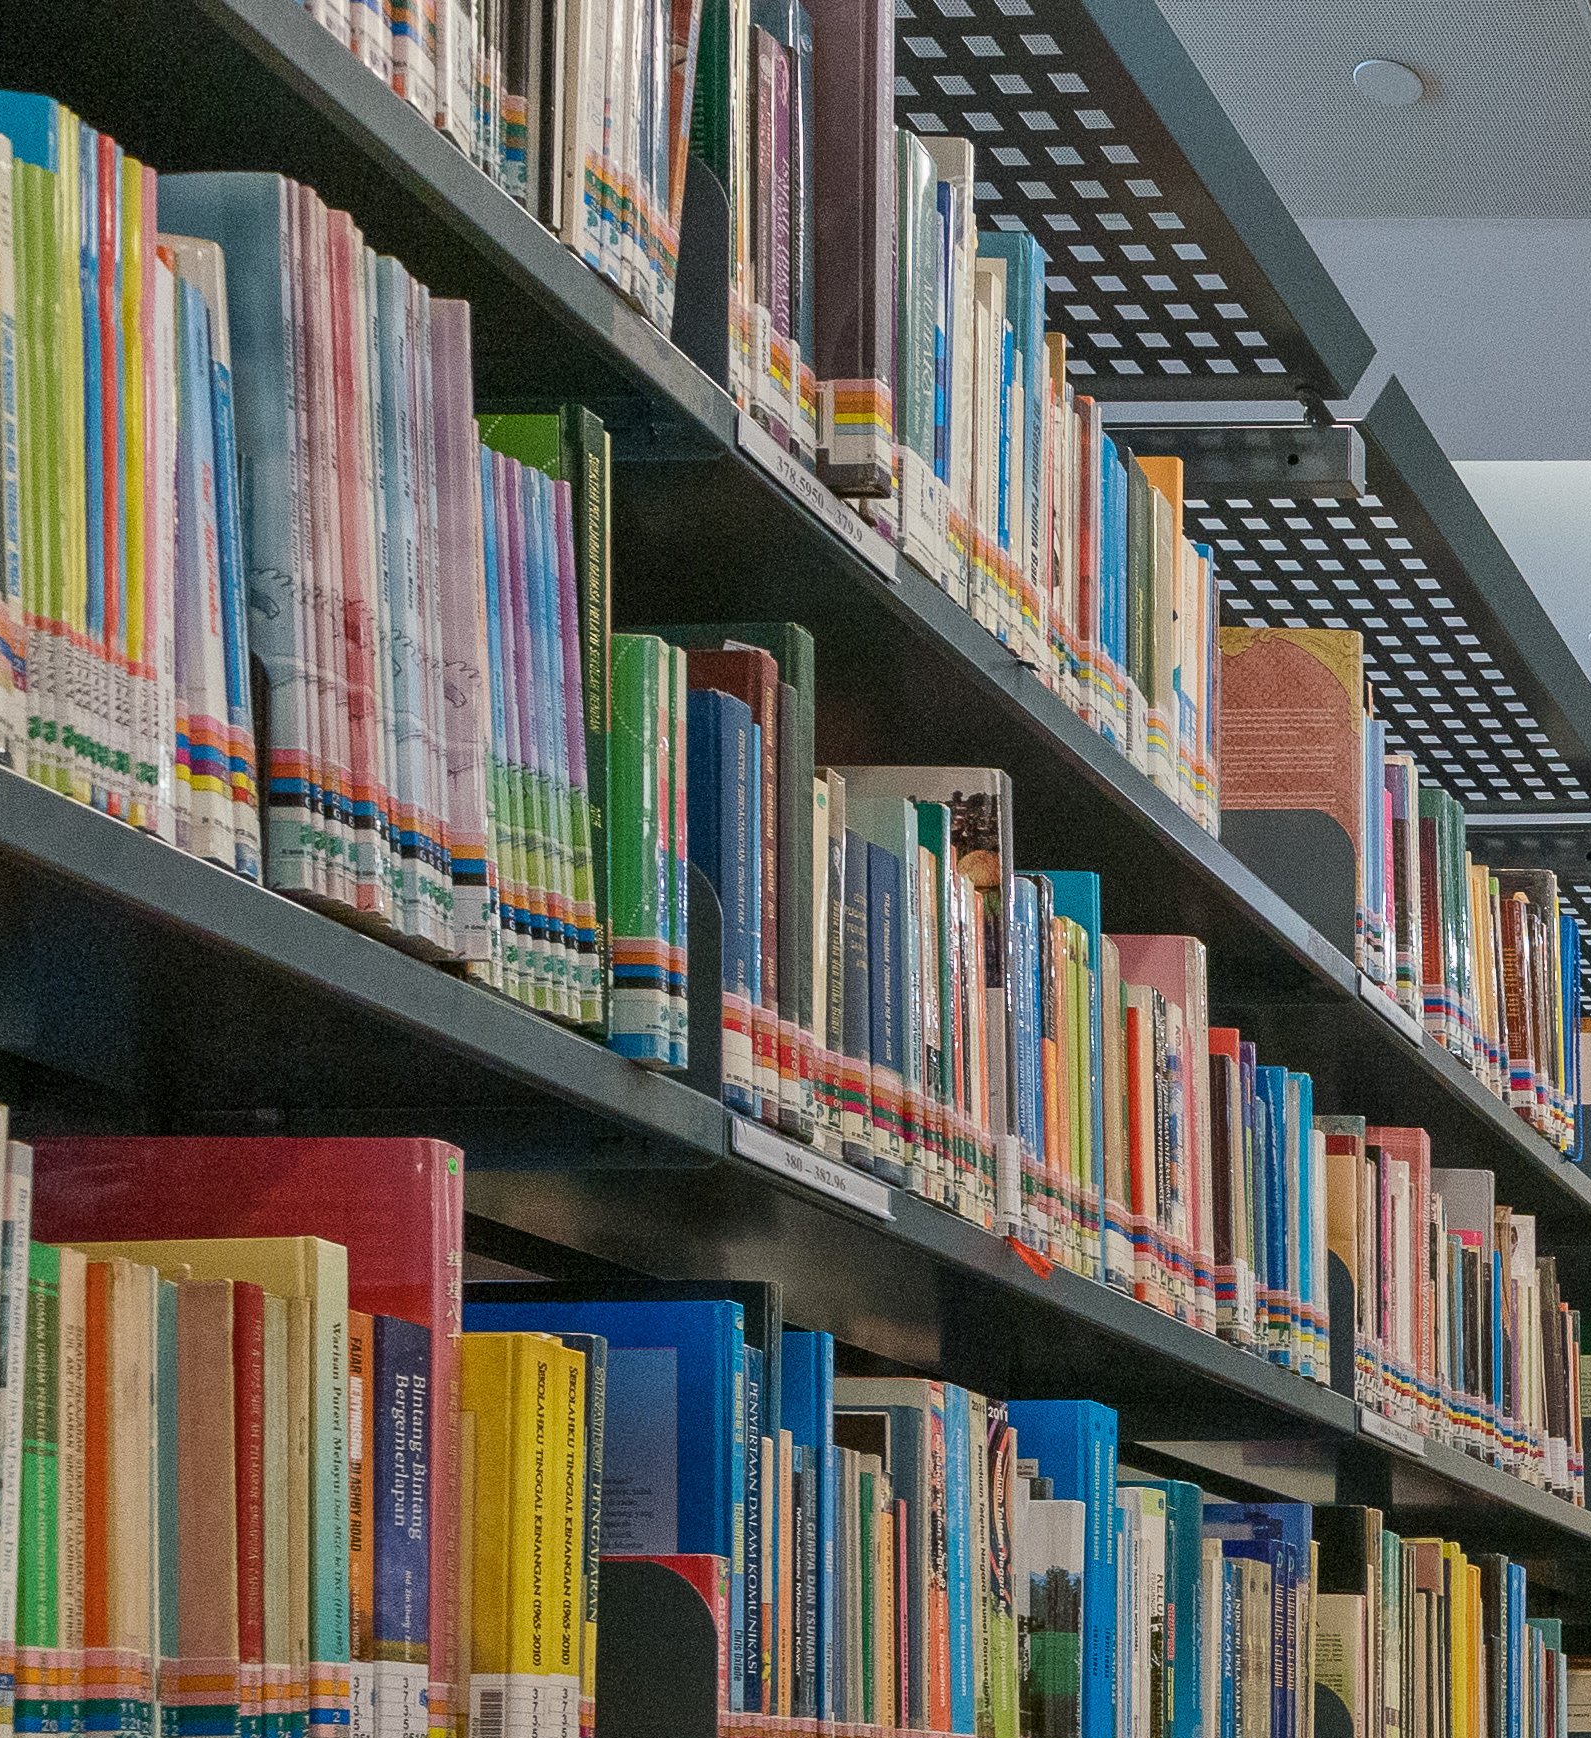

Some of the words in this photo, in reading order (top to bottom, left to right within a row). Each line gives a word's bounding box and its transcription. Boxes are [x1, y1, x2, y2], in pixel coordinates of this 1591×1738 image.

[390, 1374, 410, 1527] Bergemerlapan
[406, 1374, 427, 1540] Bintang-Bintang
[987, 1406, 1009, 1422] 2011
